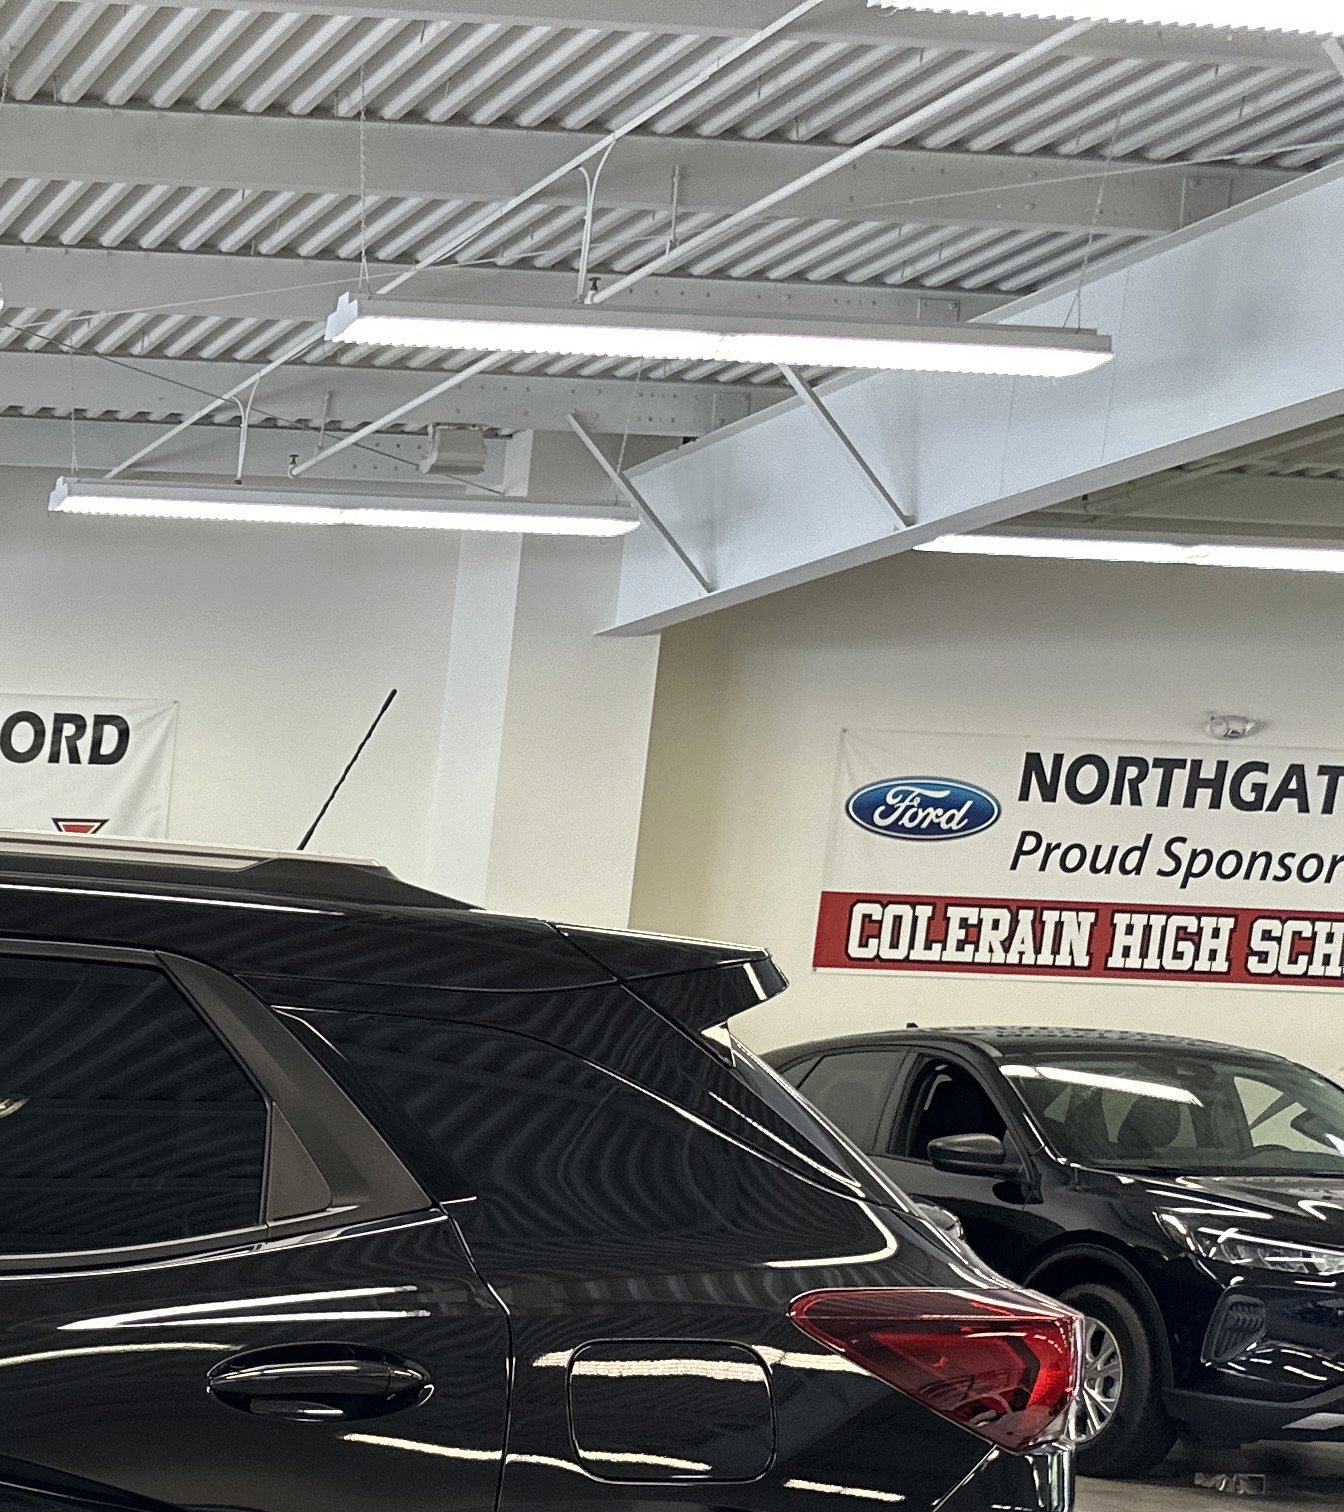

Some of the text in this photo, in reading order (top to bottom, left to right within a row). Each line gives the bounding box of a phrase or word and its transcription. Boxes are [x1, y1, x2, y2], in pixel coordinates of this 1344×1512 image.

[1018, 751, 1344, 815] NORTHGAT
[1009, 830, 1344, 889] Proud Sponsor
[847, 900, 1096, 970] COLERAIN
[1106, 911, 1236, 975] HIGH
